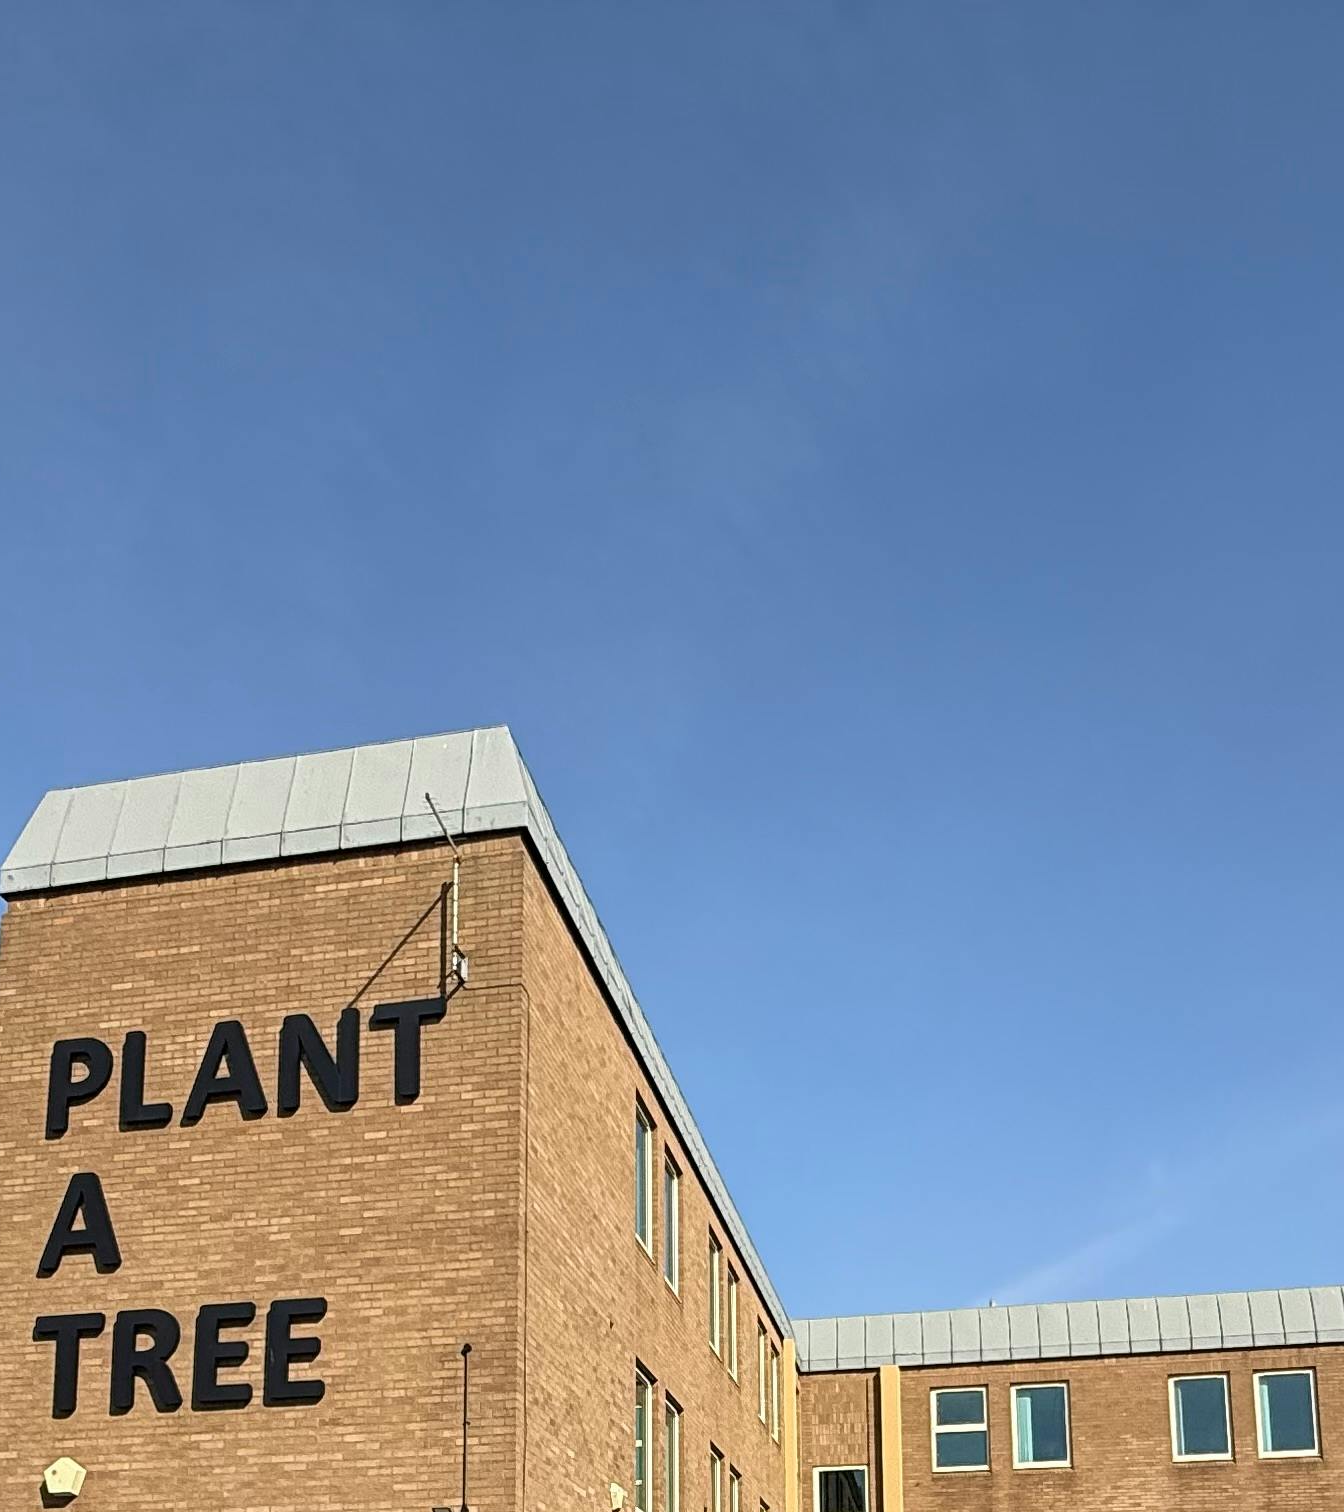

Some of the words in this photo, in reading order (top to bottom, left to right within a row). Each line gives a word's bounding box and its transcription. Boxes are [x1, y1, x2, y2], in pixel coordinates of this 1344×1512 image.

[45, 996, 448, 1140] PLANT
[36, 1172, 123, 1279] A
[32, 1297, 328, 1420] TREE
